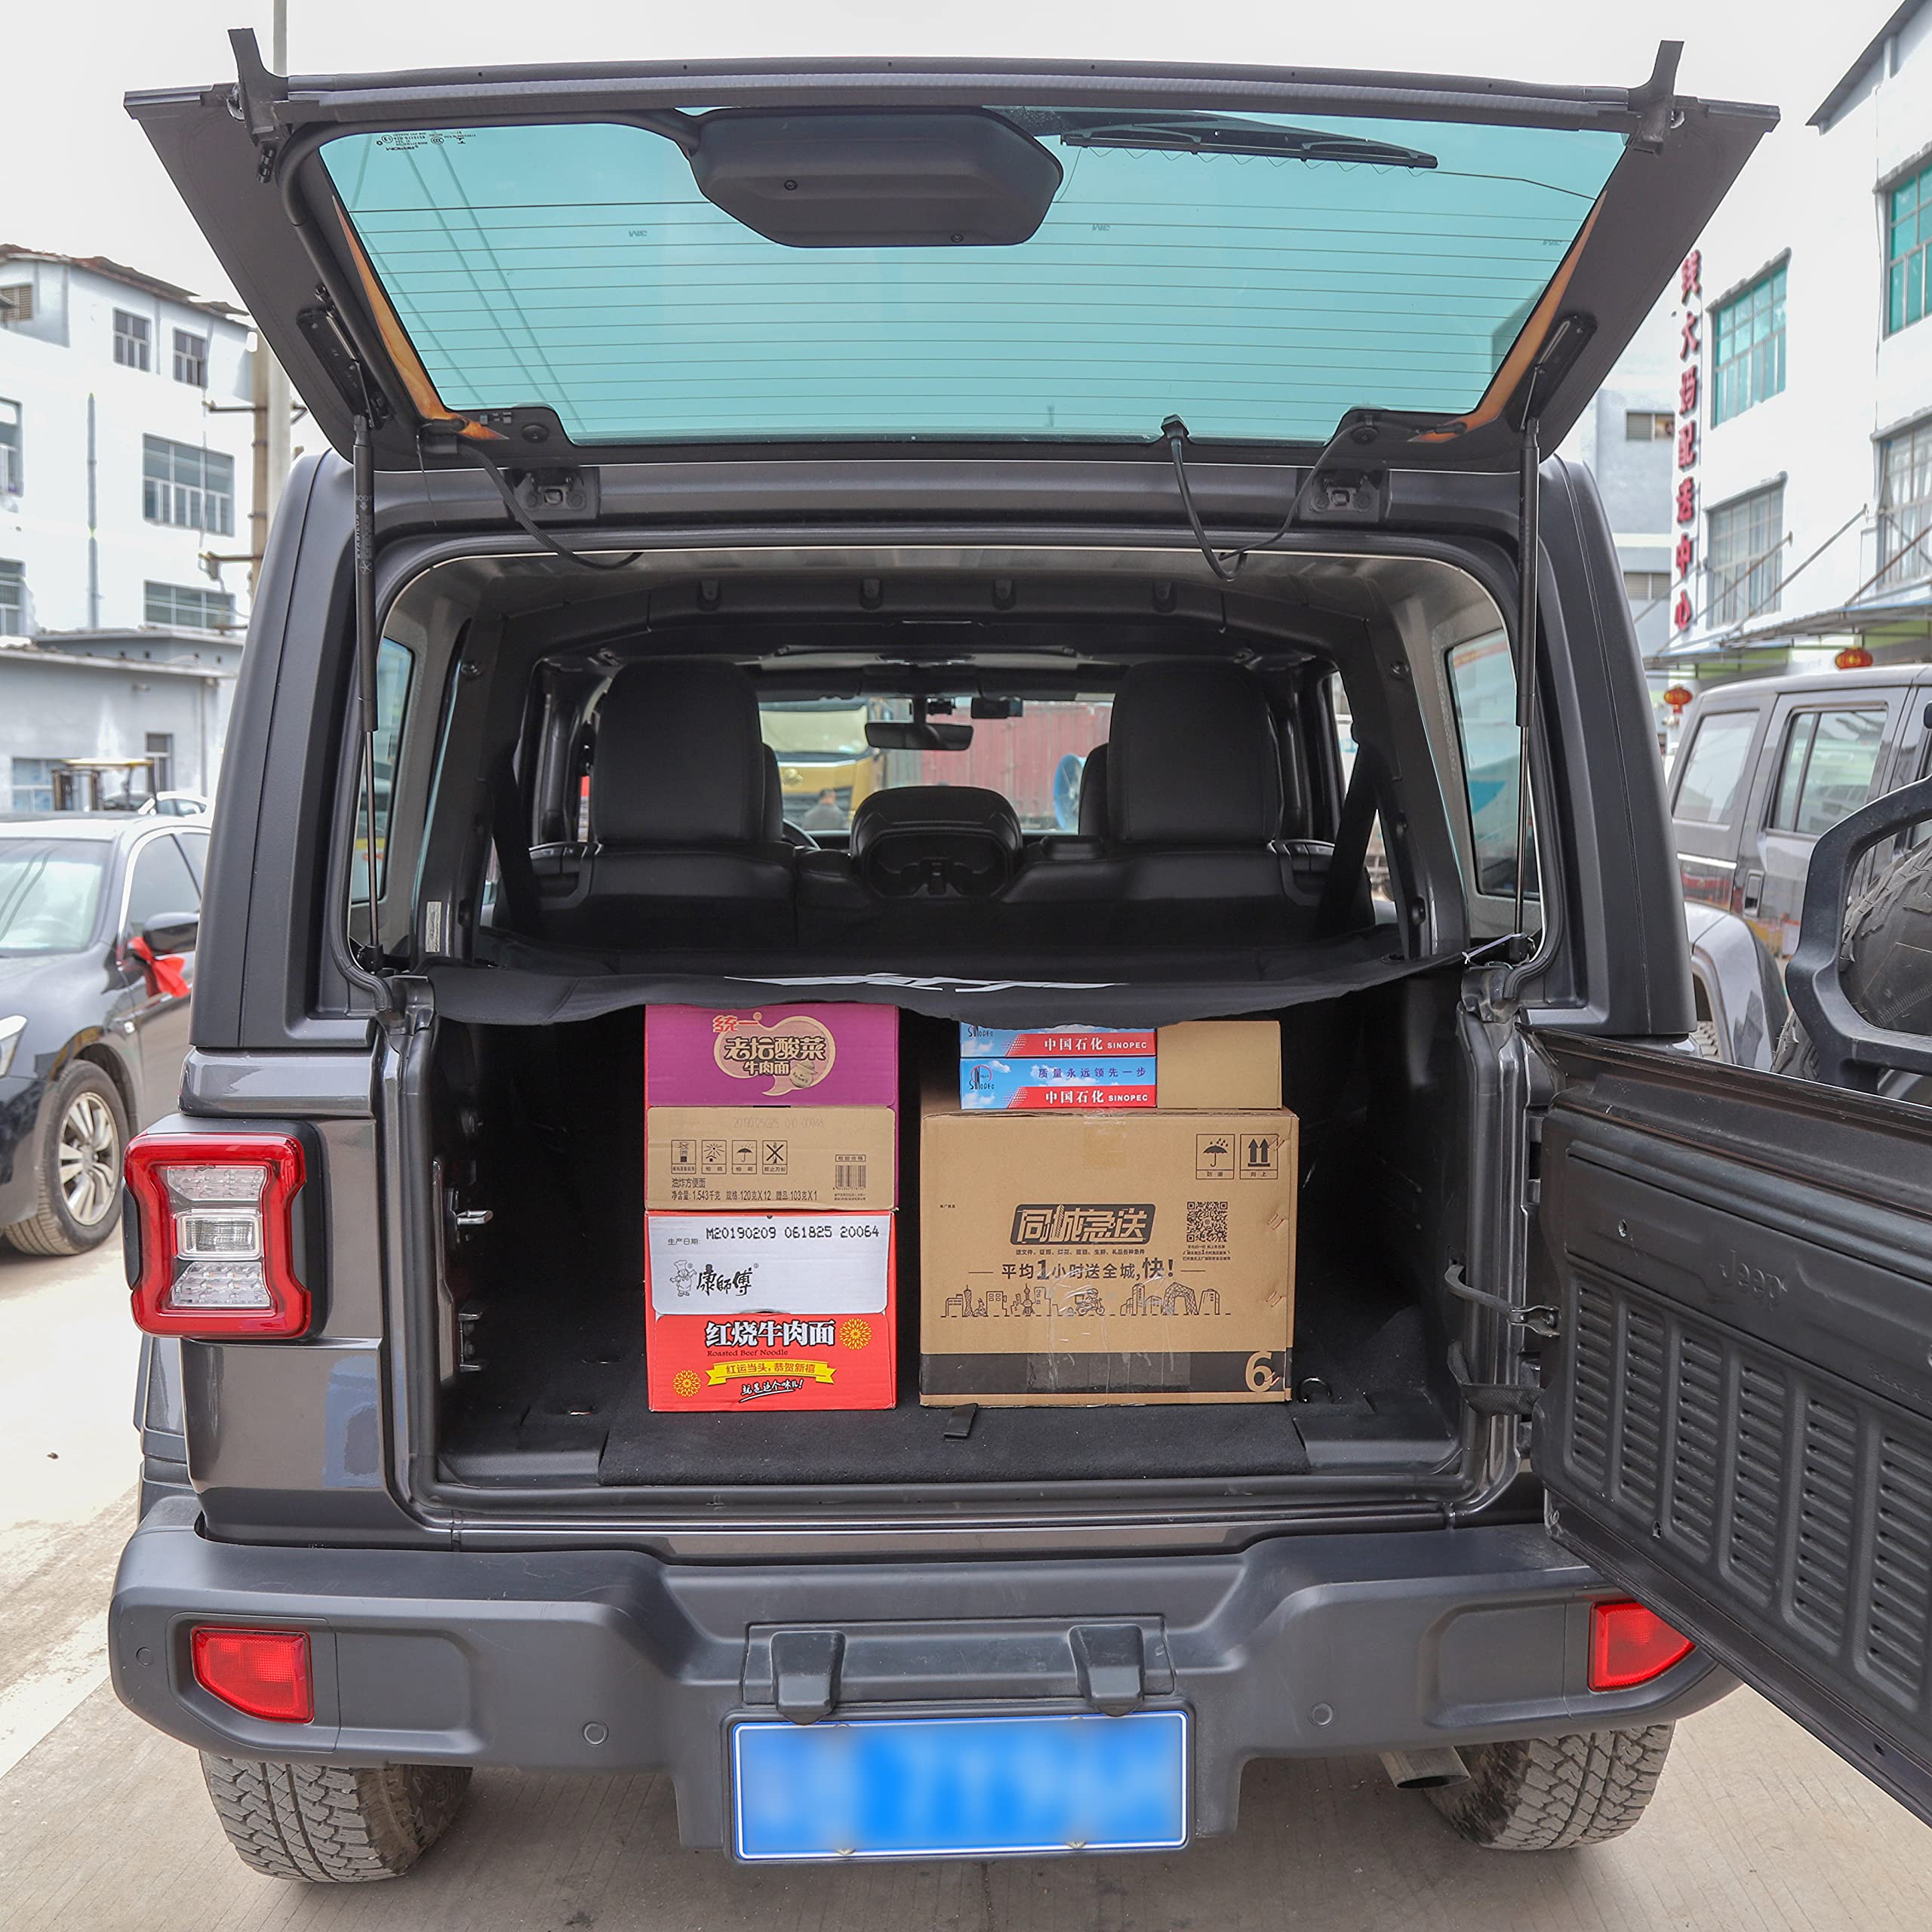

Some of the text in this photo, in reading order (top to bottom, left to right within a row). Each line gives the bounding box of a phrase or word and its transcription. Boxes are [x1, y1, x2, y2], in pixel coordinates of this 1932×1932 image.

[714, 1015, 758, 1032] 统一
[724, 1035, 826, 1060] 老坛酸菜
[1044, 1038, 1103, 1051] 中国石化
[743, 1060, 791, 1075] 牛肉面
[1038, 1067, 1146, 1078] 质量永远领先一步
[1045, 1091, 1104, 1103] 中国石化
[671, 1177, 706, 1189] 油炸方便面
[706, 1226, 879, 1239] M20190209 061825 20064
[1718, 1249, 1788, 1312] Jeep
[705, 1319, 837, 1348] 红烧牛肉面
[1245, 1351, 1273, 1392] 6
